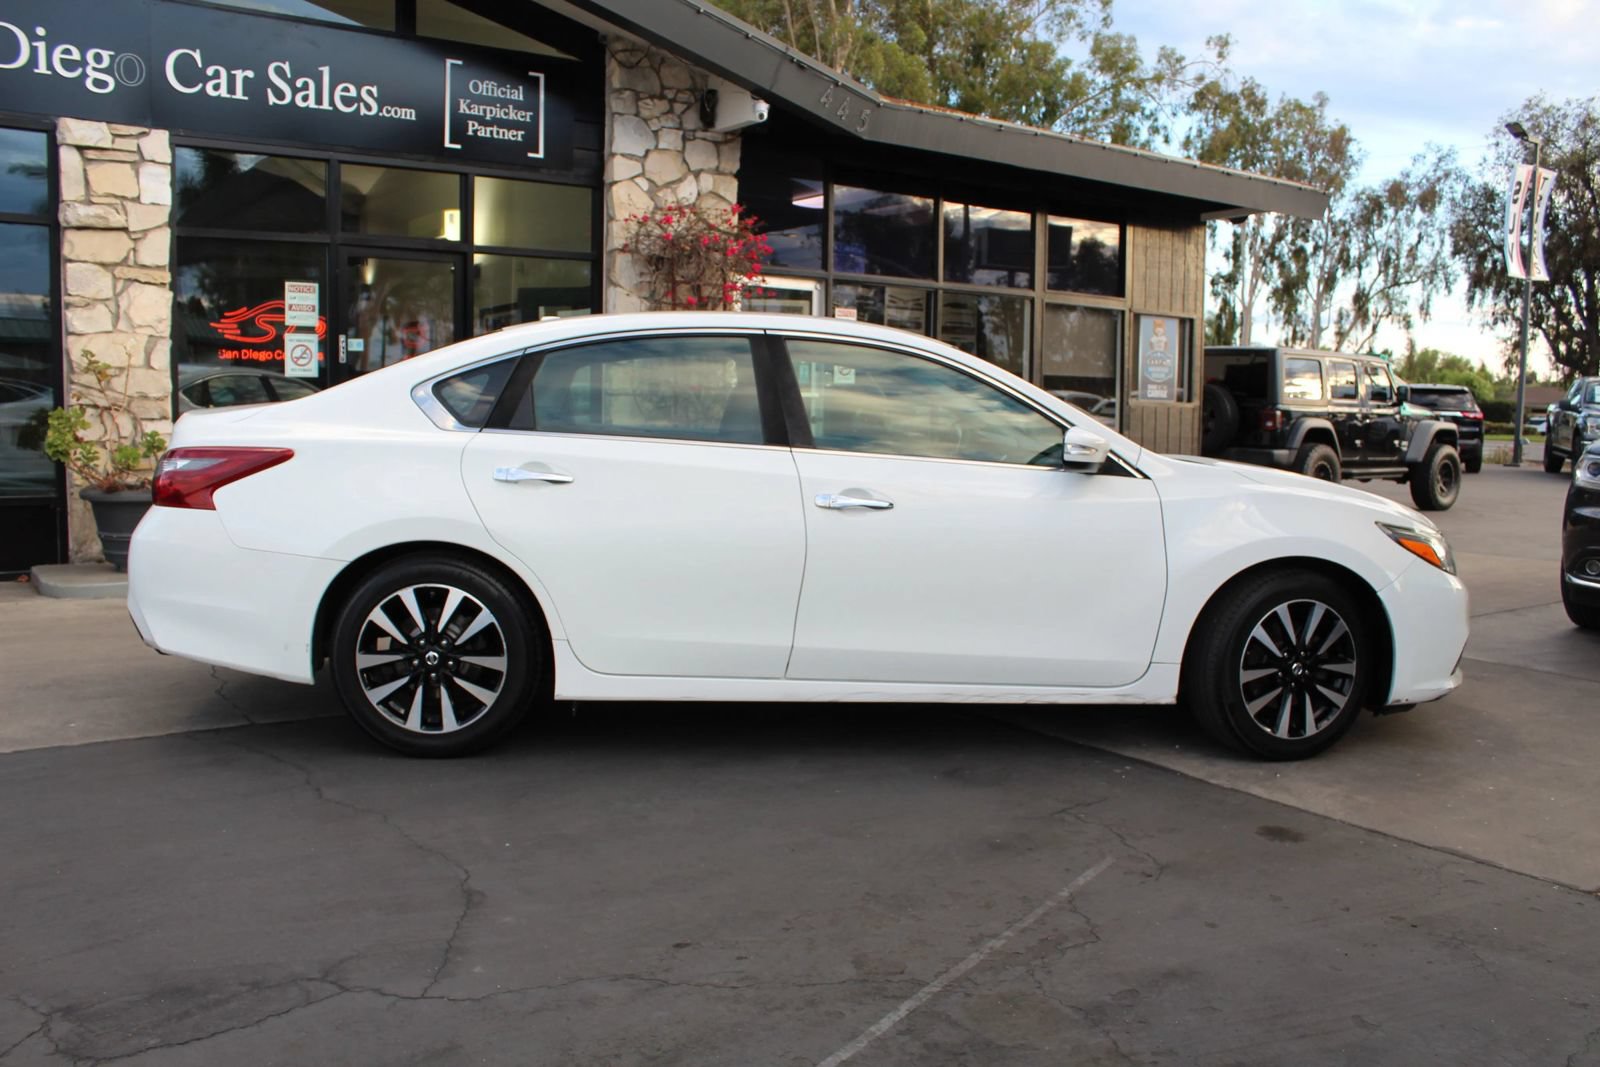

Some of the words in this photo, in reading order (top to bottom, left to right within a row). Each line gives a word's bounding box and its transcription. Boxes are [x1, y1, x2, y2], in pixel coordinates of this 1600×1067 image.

[0, 21, 146, 94] Diego
[165, 48, 255, 100] Car
[468, 79, 524, 101] Official
[458, 98, 534, 122] Karpicker
[820, 84, 871, 132] 445
[466, 120, 526, 142] Partner
[288, 285, 315, 294] NOTICE
[290, 304, 313, 312] AVISO
[241, 349, 273, 362] Diego
